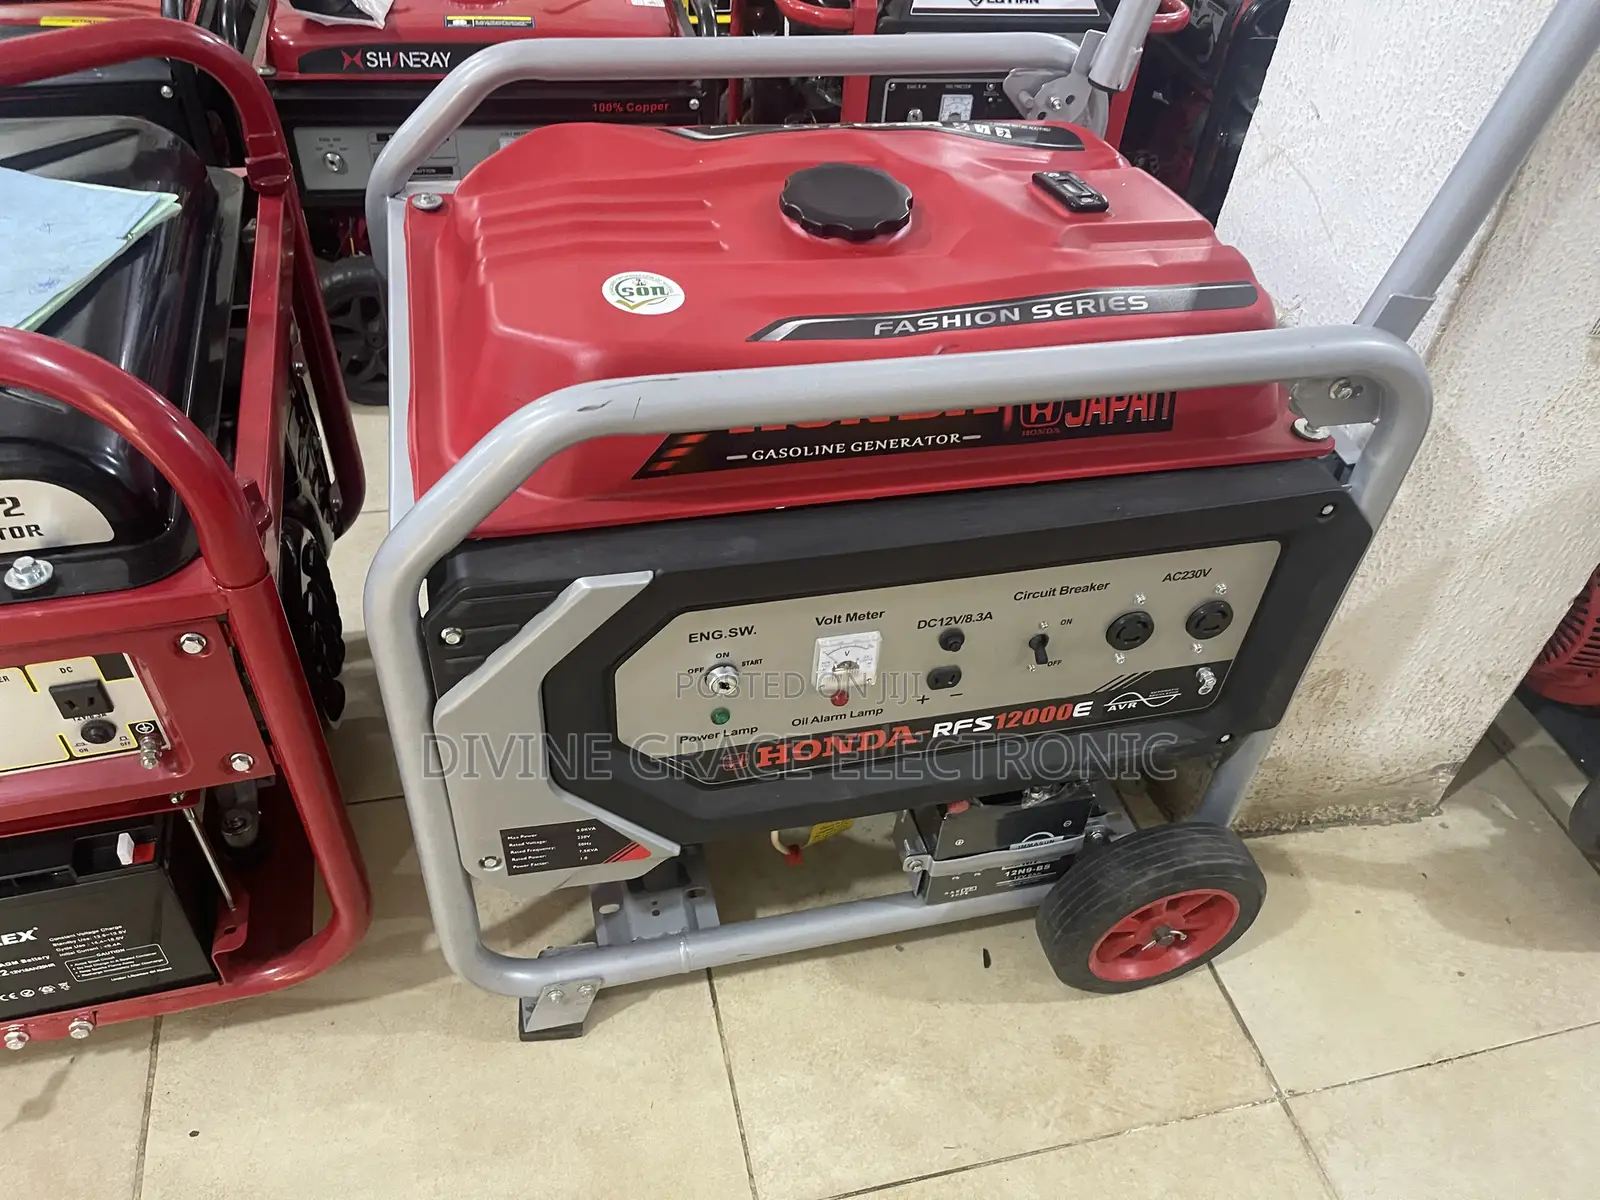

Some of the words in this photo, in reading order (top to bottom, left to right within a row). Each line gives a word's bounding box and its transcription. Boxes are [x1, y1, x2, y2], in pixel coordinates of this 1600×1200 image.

[366, 51, 451, 68] SHINERAY
[592, 103, 624, 113] 100%
[626, 102, 669, 113] Copper
[873, 306, 1021, 336] FASHION
[1031, 295, 1150, 320] SERIES
[751, 443, 846, 461] GASOLINE
[850, 432, 961, 453] GENERATOR
[1161, 568, 1213, 584] AC230V
[1013, 586, 1057, 602] Circuit
[1059, 580, 1111, 597] Breaker
[815, 614, 842, 627] Volt
[845, 610, 885, 623] Meter
[917, 610, 993, 630] DC12V/8.3A
[1060, 617, 1073, 626] ON
[688, 625, 758, 644] ENG.SW.
[715, 651, 730, 659] ON
[741, 658, 763, 667] START
[59, 665, 74, 675] DC
[687, 667, 704, 675] OFF
[1047, 659, 1062, 668] OFF
[1107, 702, 1138, 713] AVR
[791, 717, 809, 728] Oil
[811, 711, 847, 724] Alarm
[849, 706, 884, 719] Lamp
[679, 730, 720, 745] Power
[723, 725, 759, 739] Lamp
